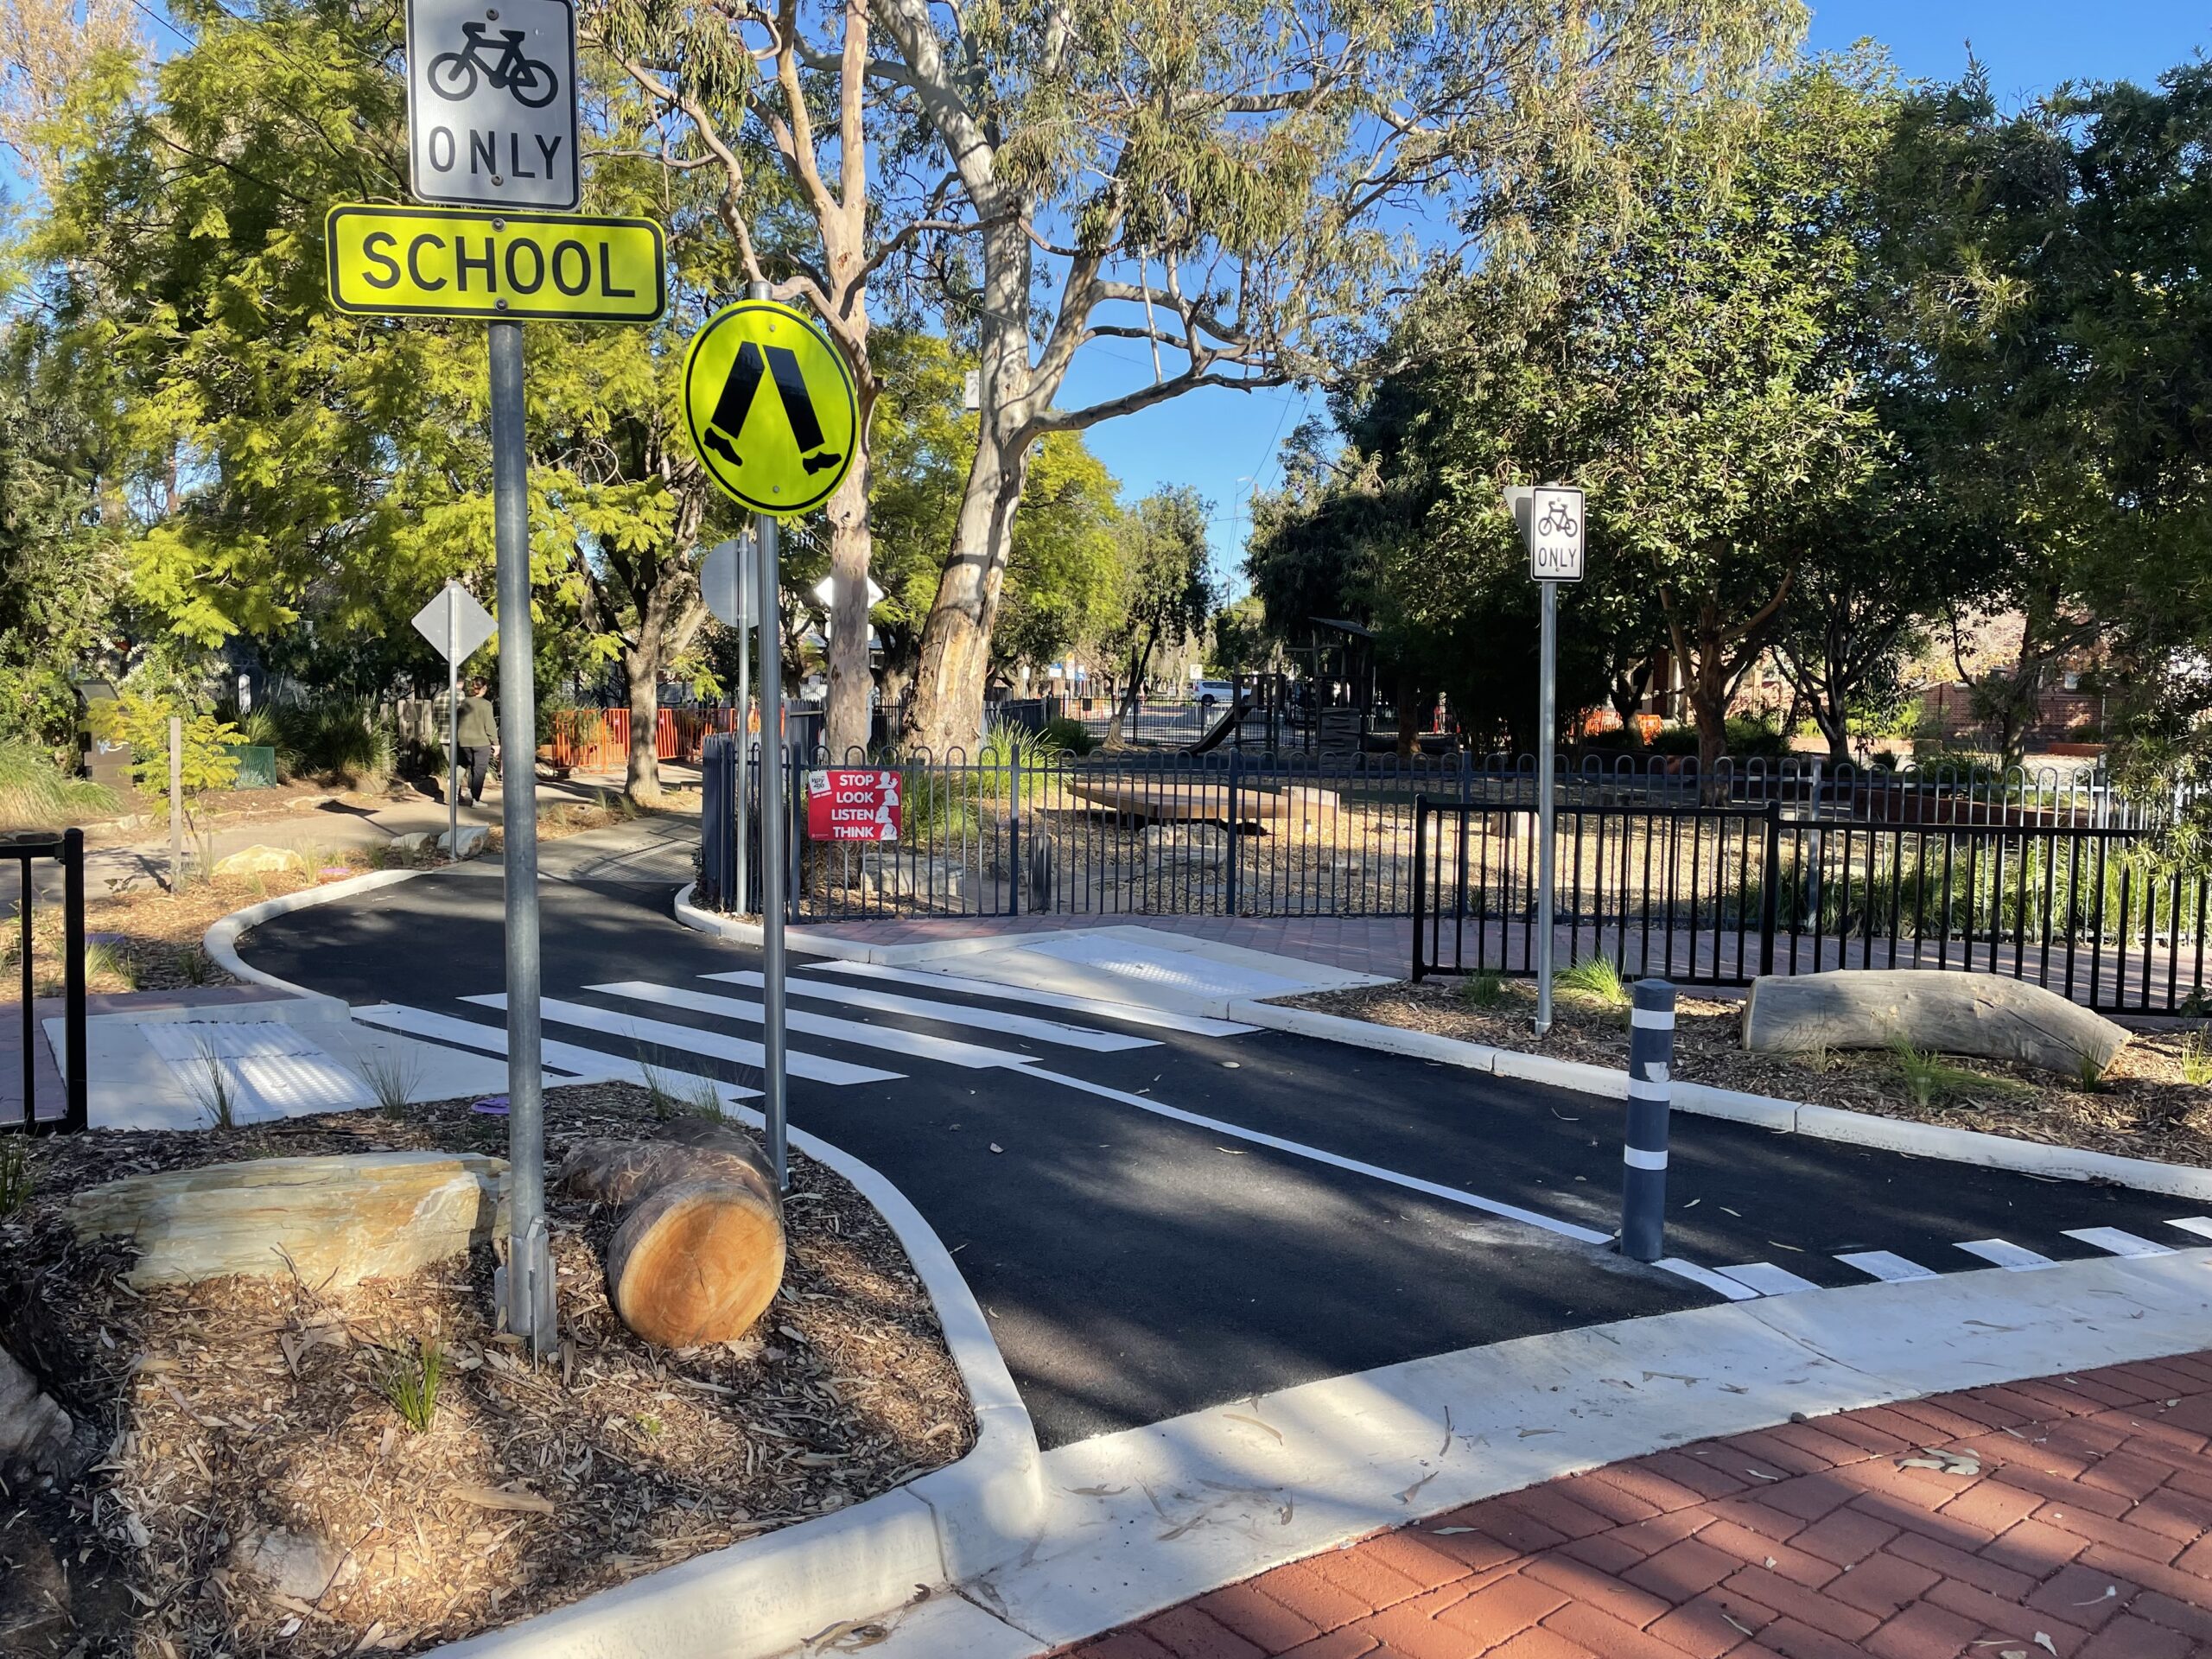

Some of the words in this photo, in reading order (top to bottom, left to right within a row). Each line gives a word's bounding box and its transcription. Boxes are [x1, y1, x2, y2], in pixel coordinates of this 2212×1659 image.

[429, 125, 562, 181] ONLY
[362, 232, 635, 298] SCHOOL
[1538, 547, 1577, 568] ONLY
[839, 774, 874, 786] STOP
[836, 791, 874, 804] LOOK
[831, 809, 874, 821] LISTEN
[832, 826, 874, 838] THINK
